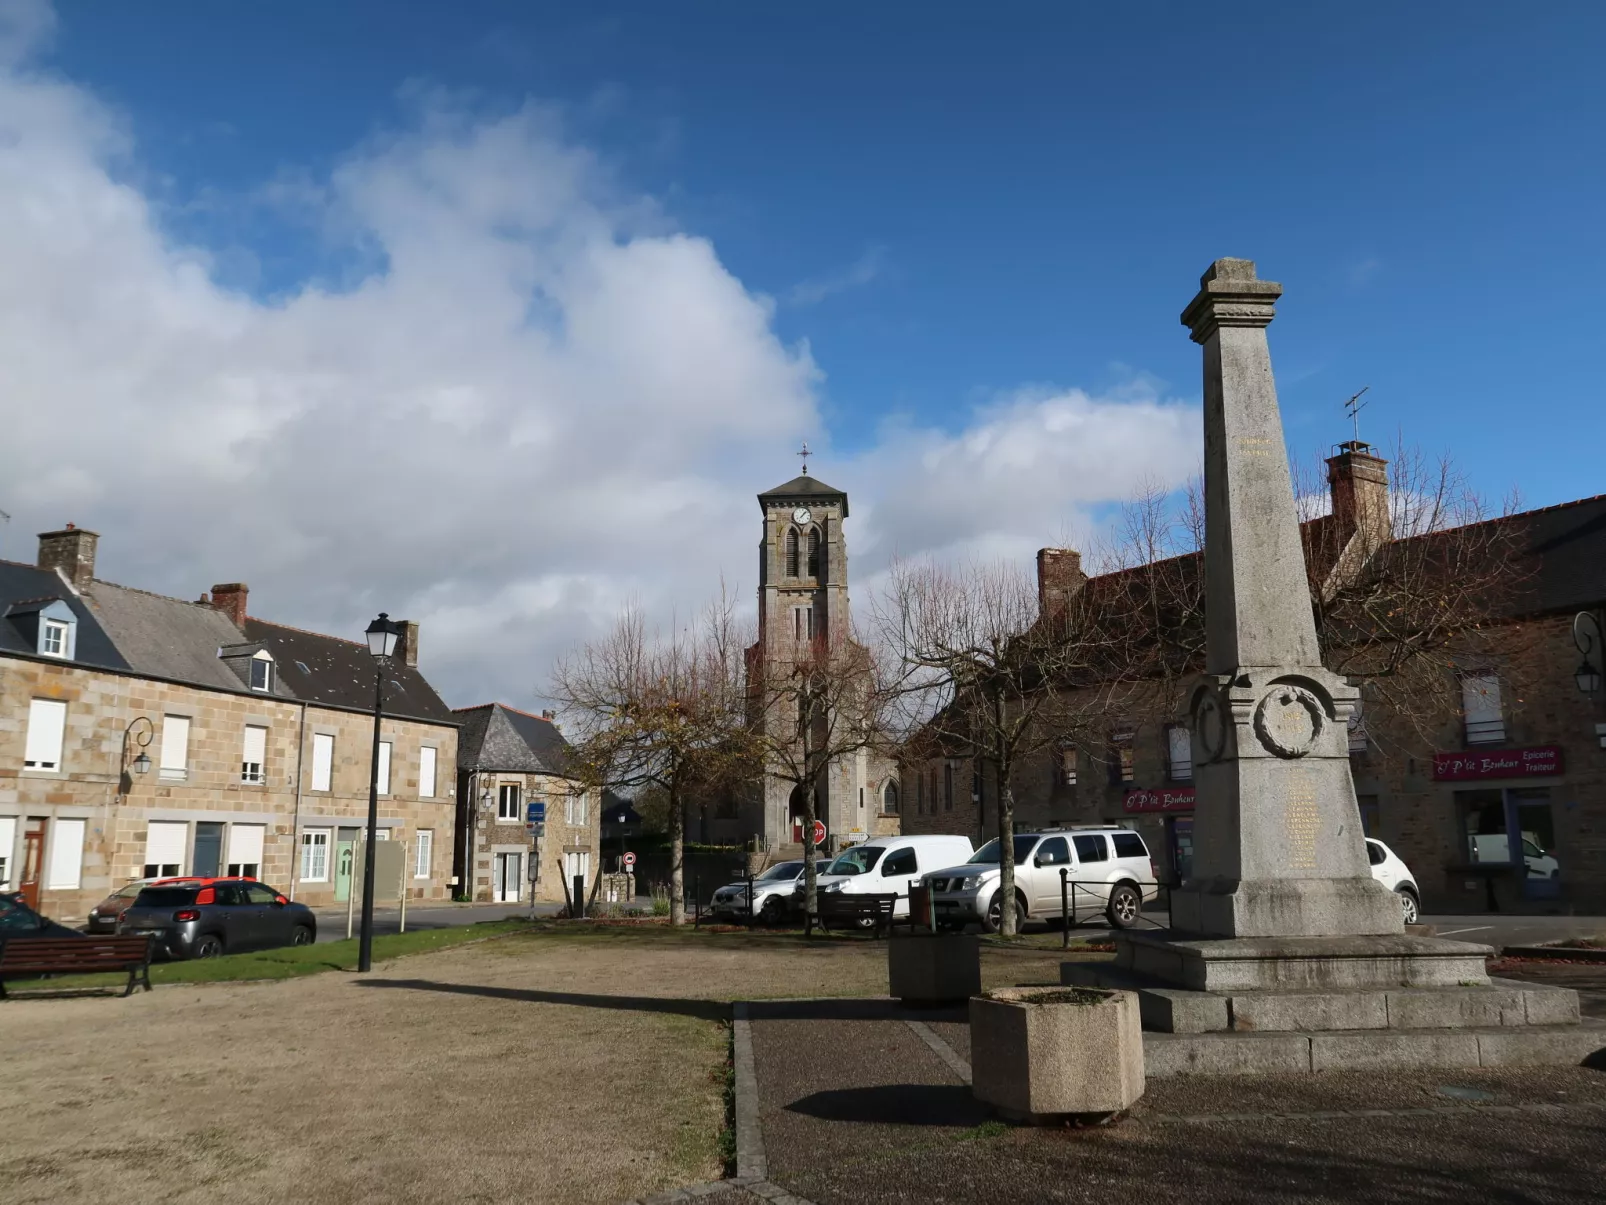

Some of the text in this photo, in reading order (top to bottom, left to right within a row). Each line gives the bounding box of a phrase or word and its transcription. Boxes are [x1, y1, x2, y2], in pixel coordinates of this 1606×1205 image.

[1522, 750, 1556, 761] Epicerie
[1452, 758, 1476, 774] P'tit
[1480, 757, 1519, 773] Bonheur
[1525, 763, 1556, 772] Traiteur
[1162, 792, 1195, 808] Bonheur
